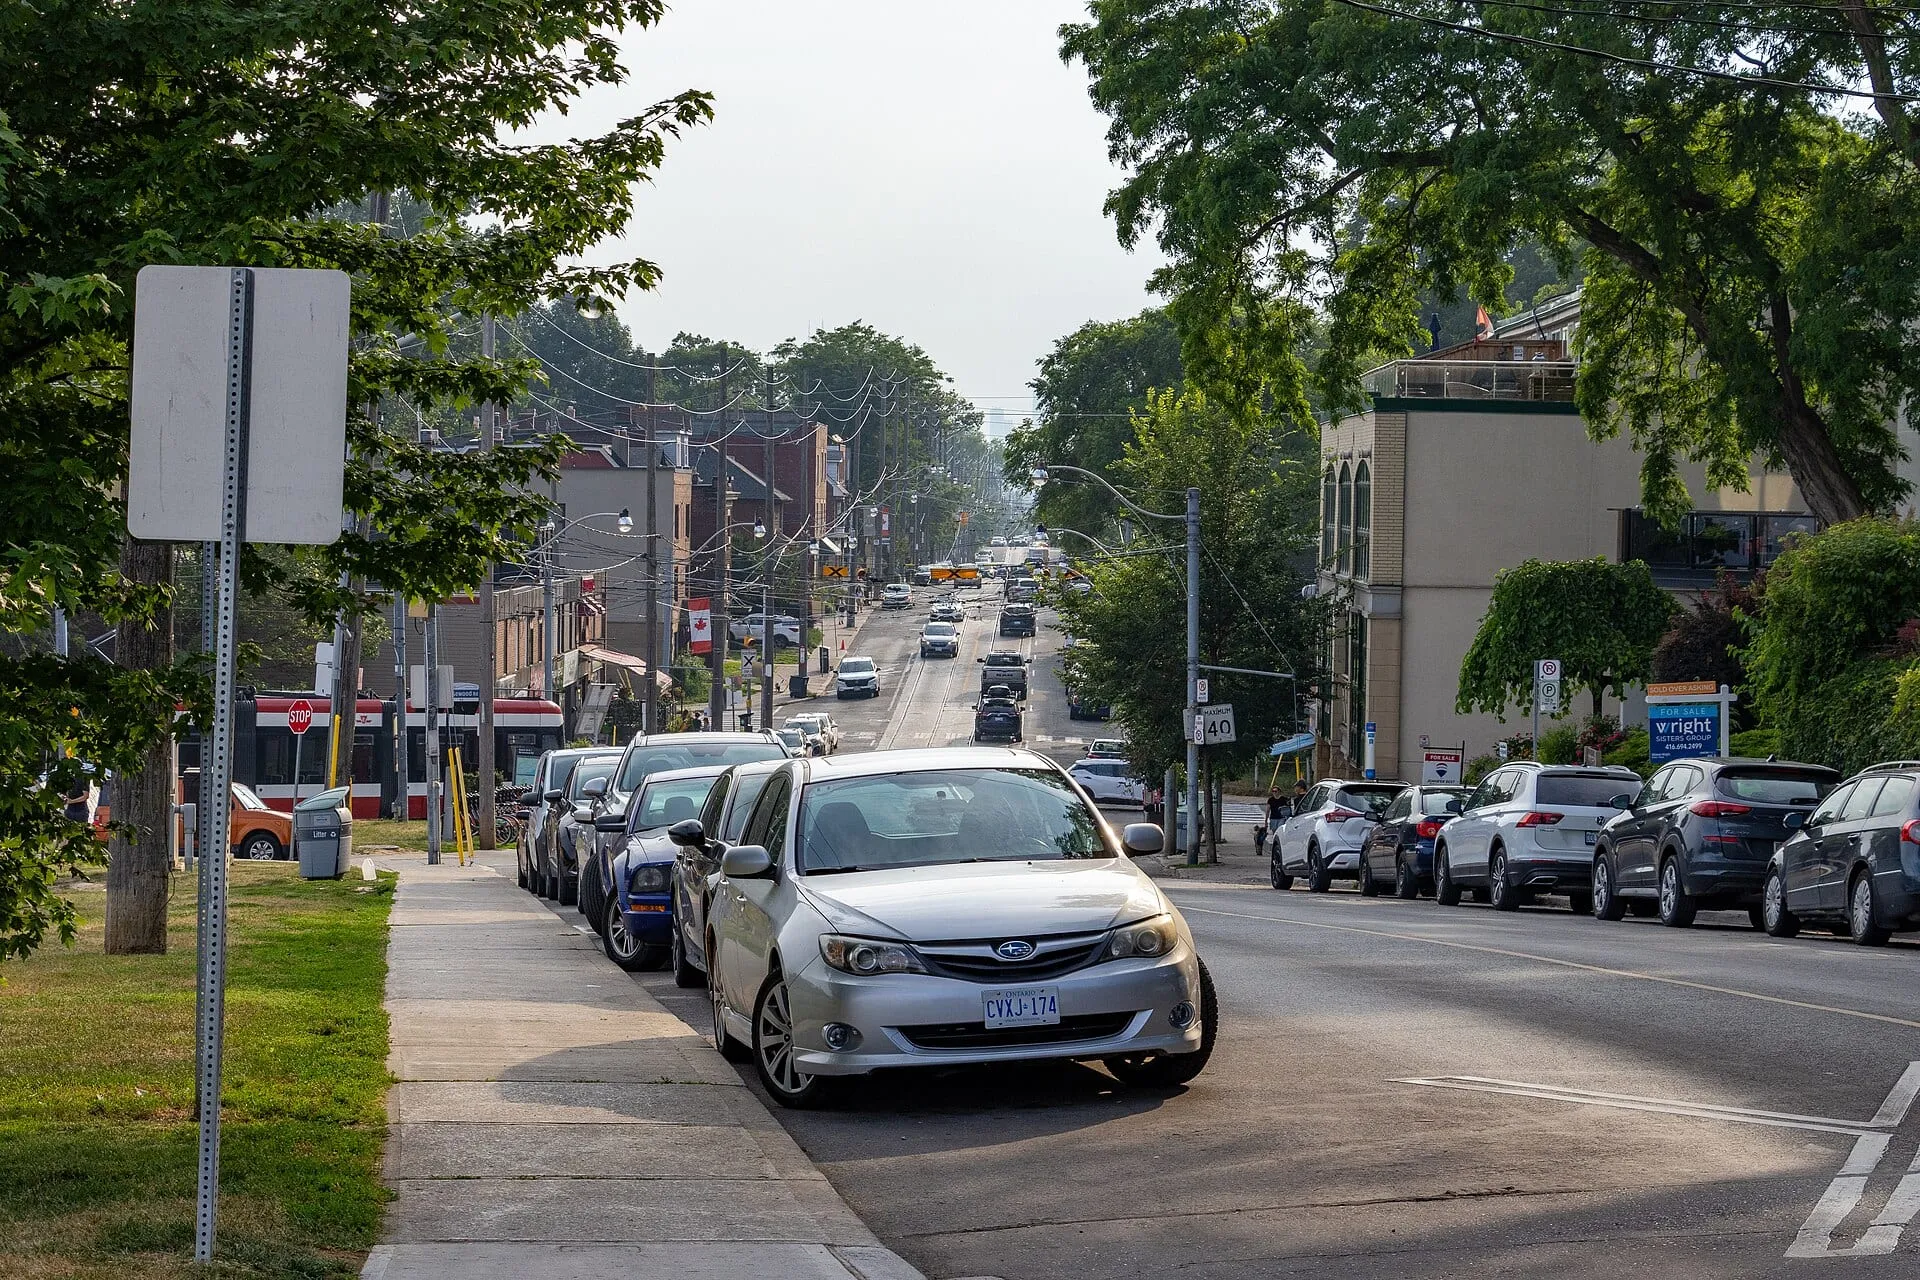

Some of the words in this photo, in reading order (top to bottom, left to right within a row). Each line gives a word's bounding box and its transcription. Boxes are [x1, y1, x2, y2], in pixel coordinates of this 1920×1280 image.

[1688, 683, 1714, 691] ASKING
[1205, 707, 1231, 716] MAXIMUM
[1660, 708, 1679, 716] FOR
[1683, 707, 1706, 715] SALE
[290, 710, 311, 723] STOP
[1207, 719, 1231, 737] 40
[1656, 718, 1711, 735] wright
[1005, 990, 1036, 998] ONTARIO
